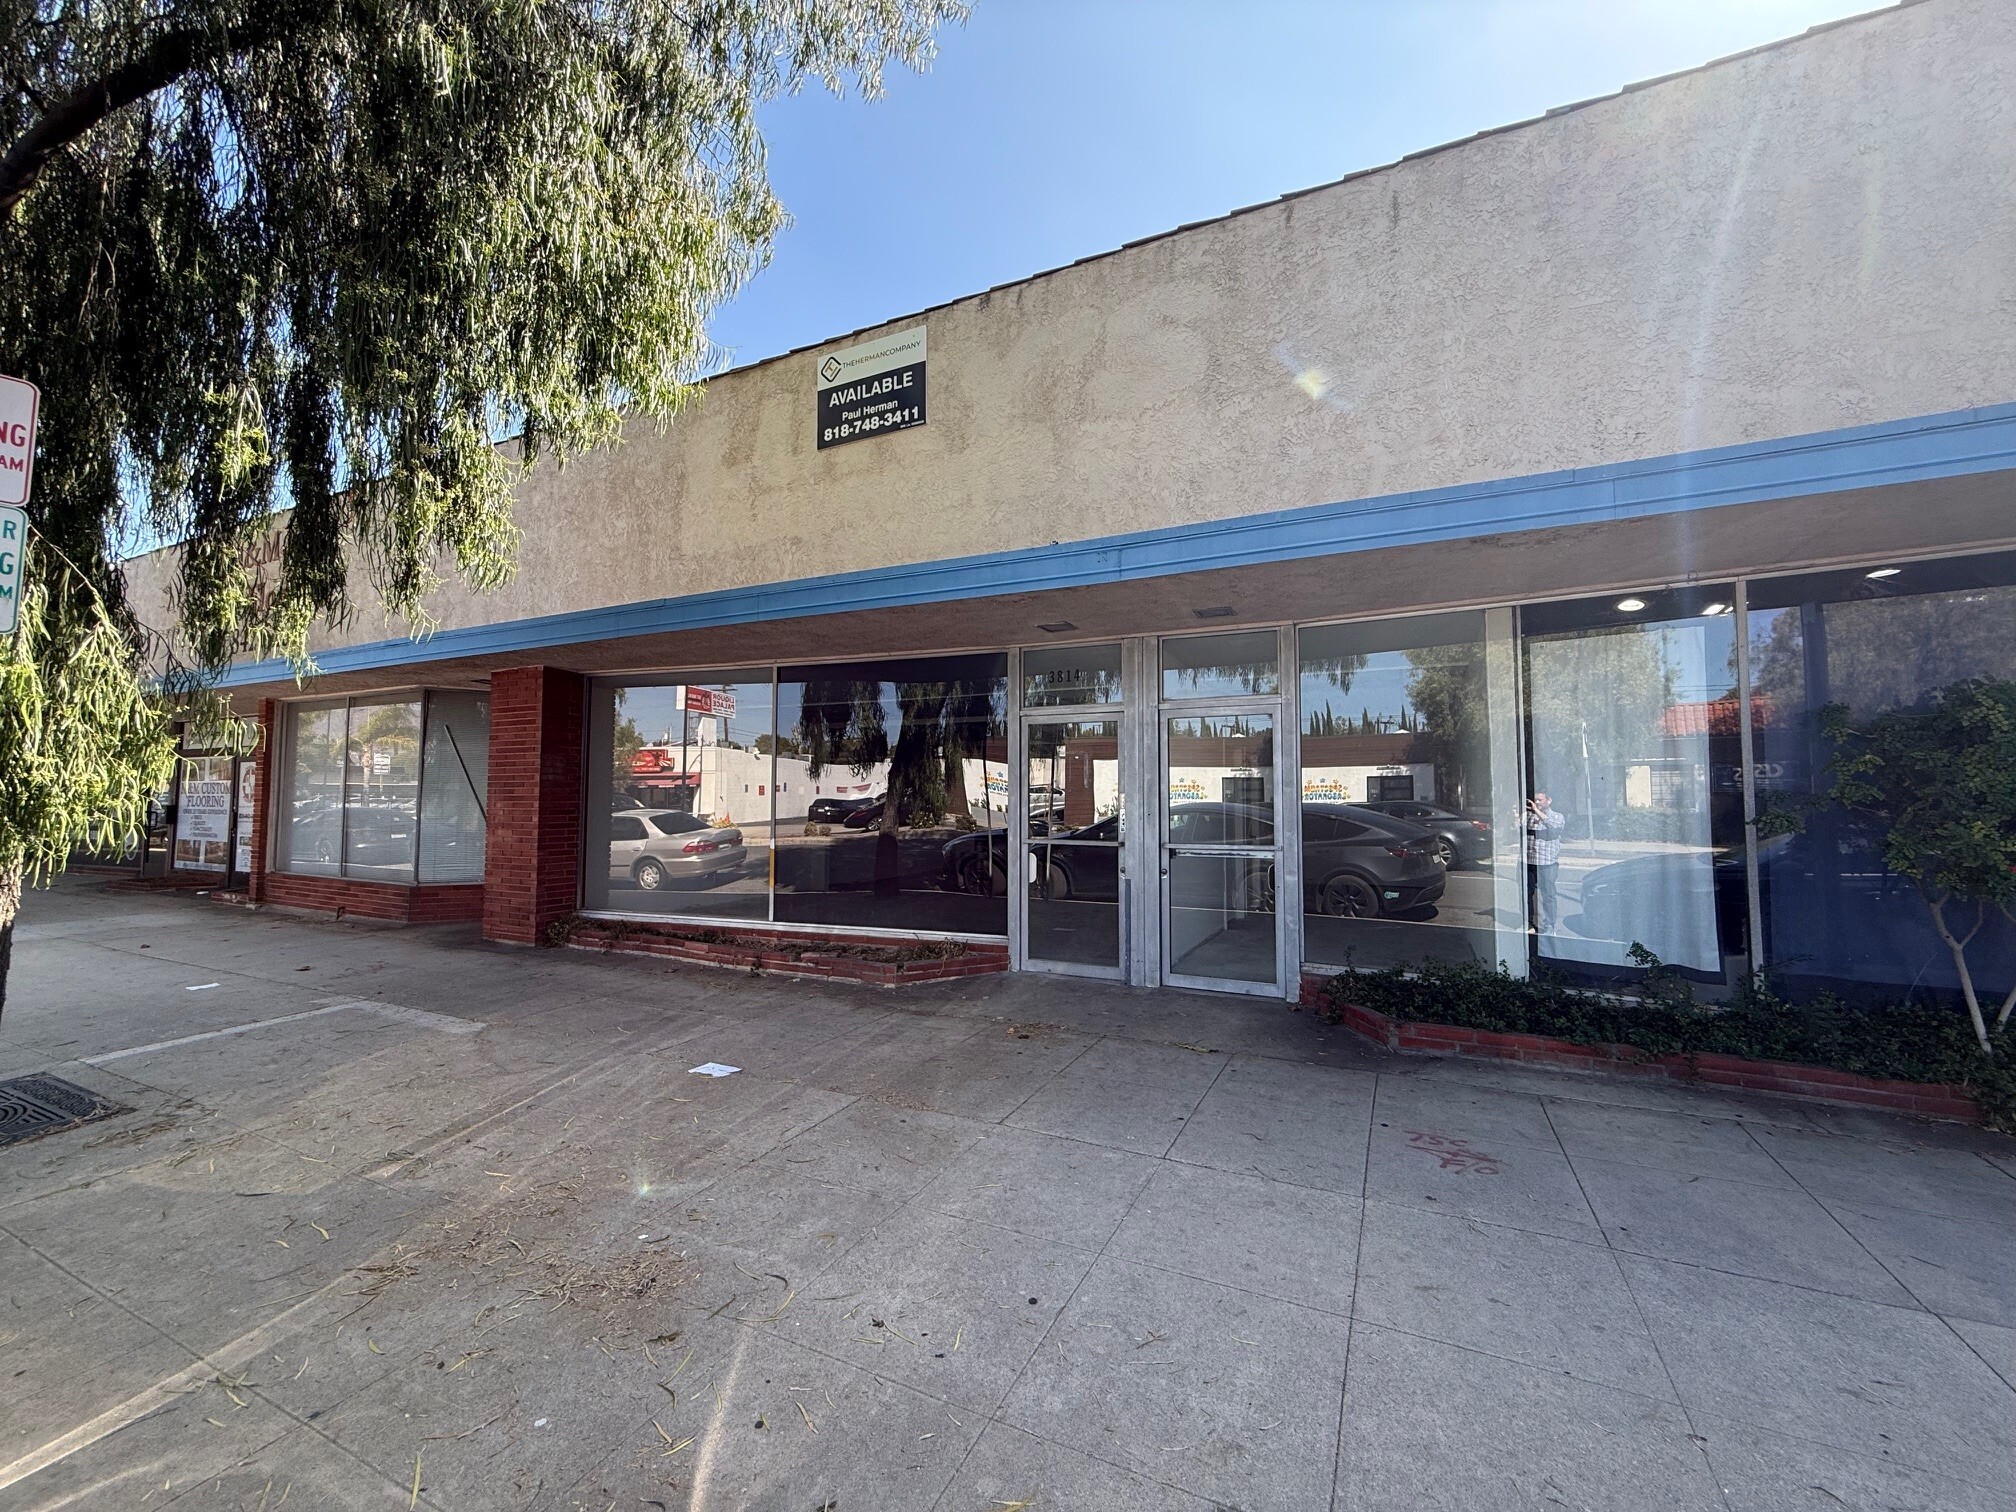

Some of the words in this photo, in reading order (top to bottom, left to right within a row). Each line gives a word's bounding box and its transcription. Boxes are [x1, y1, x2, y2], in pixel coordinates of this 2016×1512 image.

[829, 371, 913, 408] AVAILABLE
[841, 408, 861, 422] Paul
[863, 400, 898, 416] Herman
[824, 406, 919, 441] 818-748-3411
[3, 520, 17, 540] R
[1049, 669, 1080, 684] 3814
[186, 795, 225, 808] FLOORING
